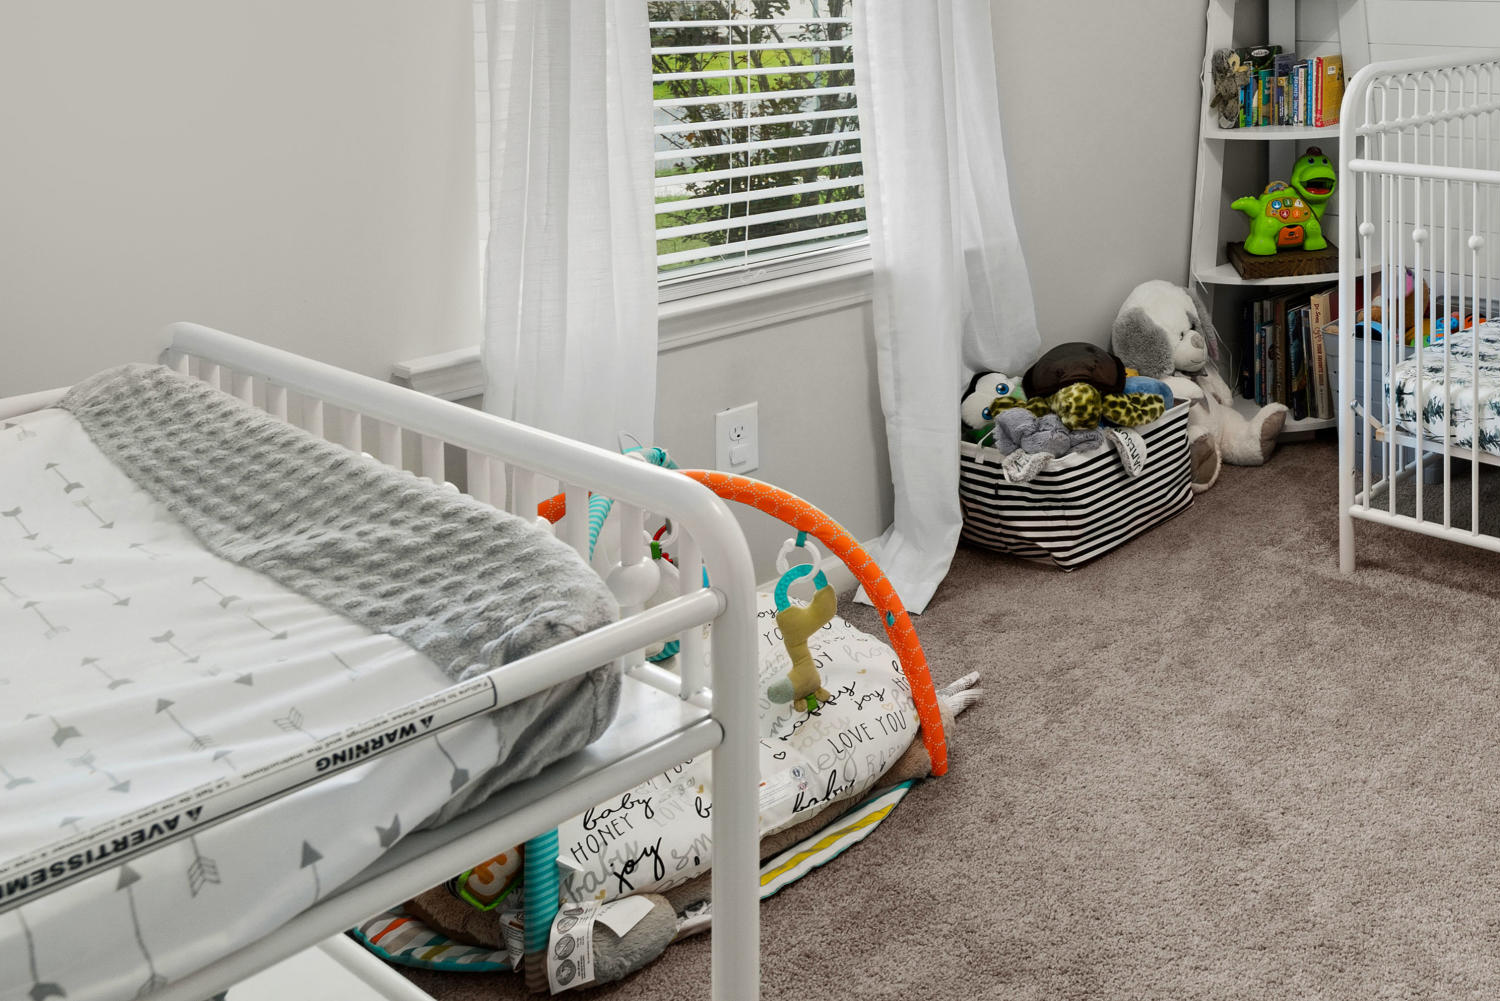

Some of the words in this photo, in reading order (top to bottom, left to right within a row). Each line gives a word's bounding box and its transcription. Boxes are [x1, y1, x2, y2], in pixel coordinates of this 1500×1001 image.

[851, 687, 886, 711] joy
[316, 723, 418, 772] WARNING
[828, 722, 875, 755] LOVE
[874, 709, 908, 737] YOU
[582, 791, 655, 832] baby
[570, 812, 635, 864] HONEY
[609, 836, 666, 895] joy
